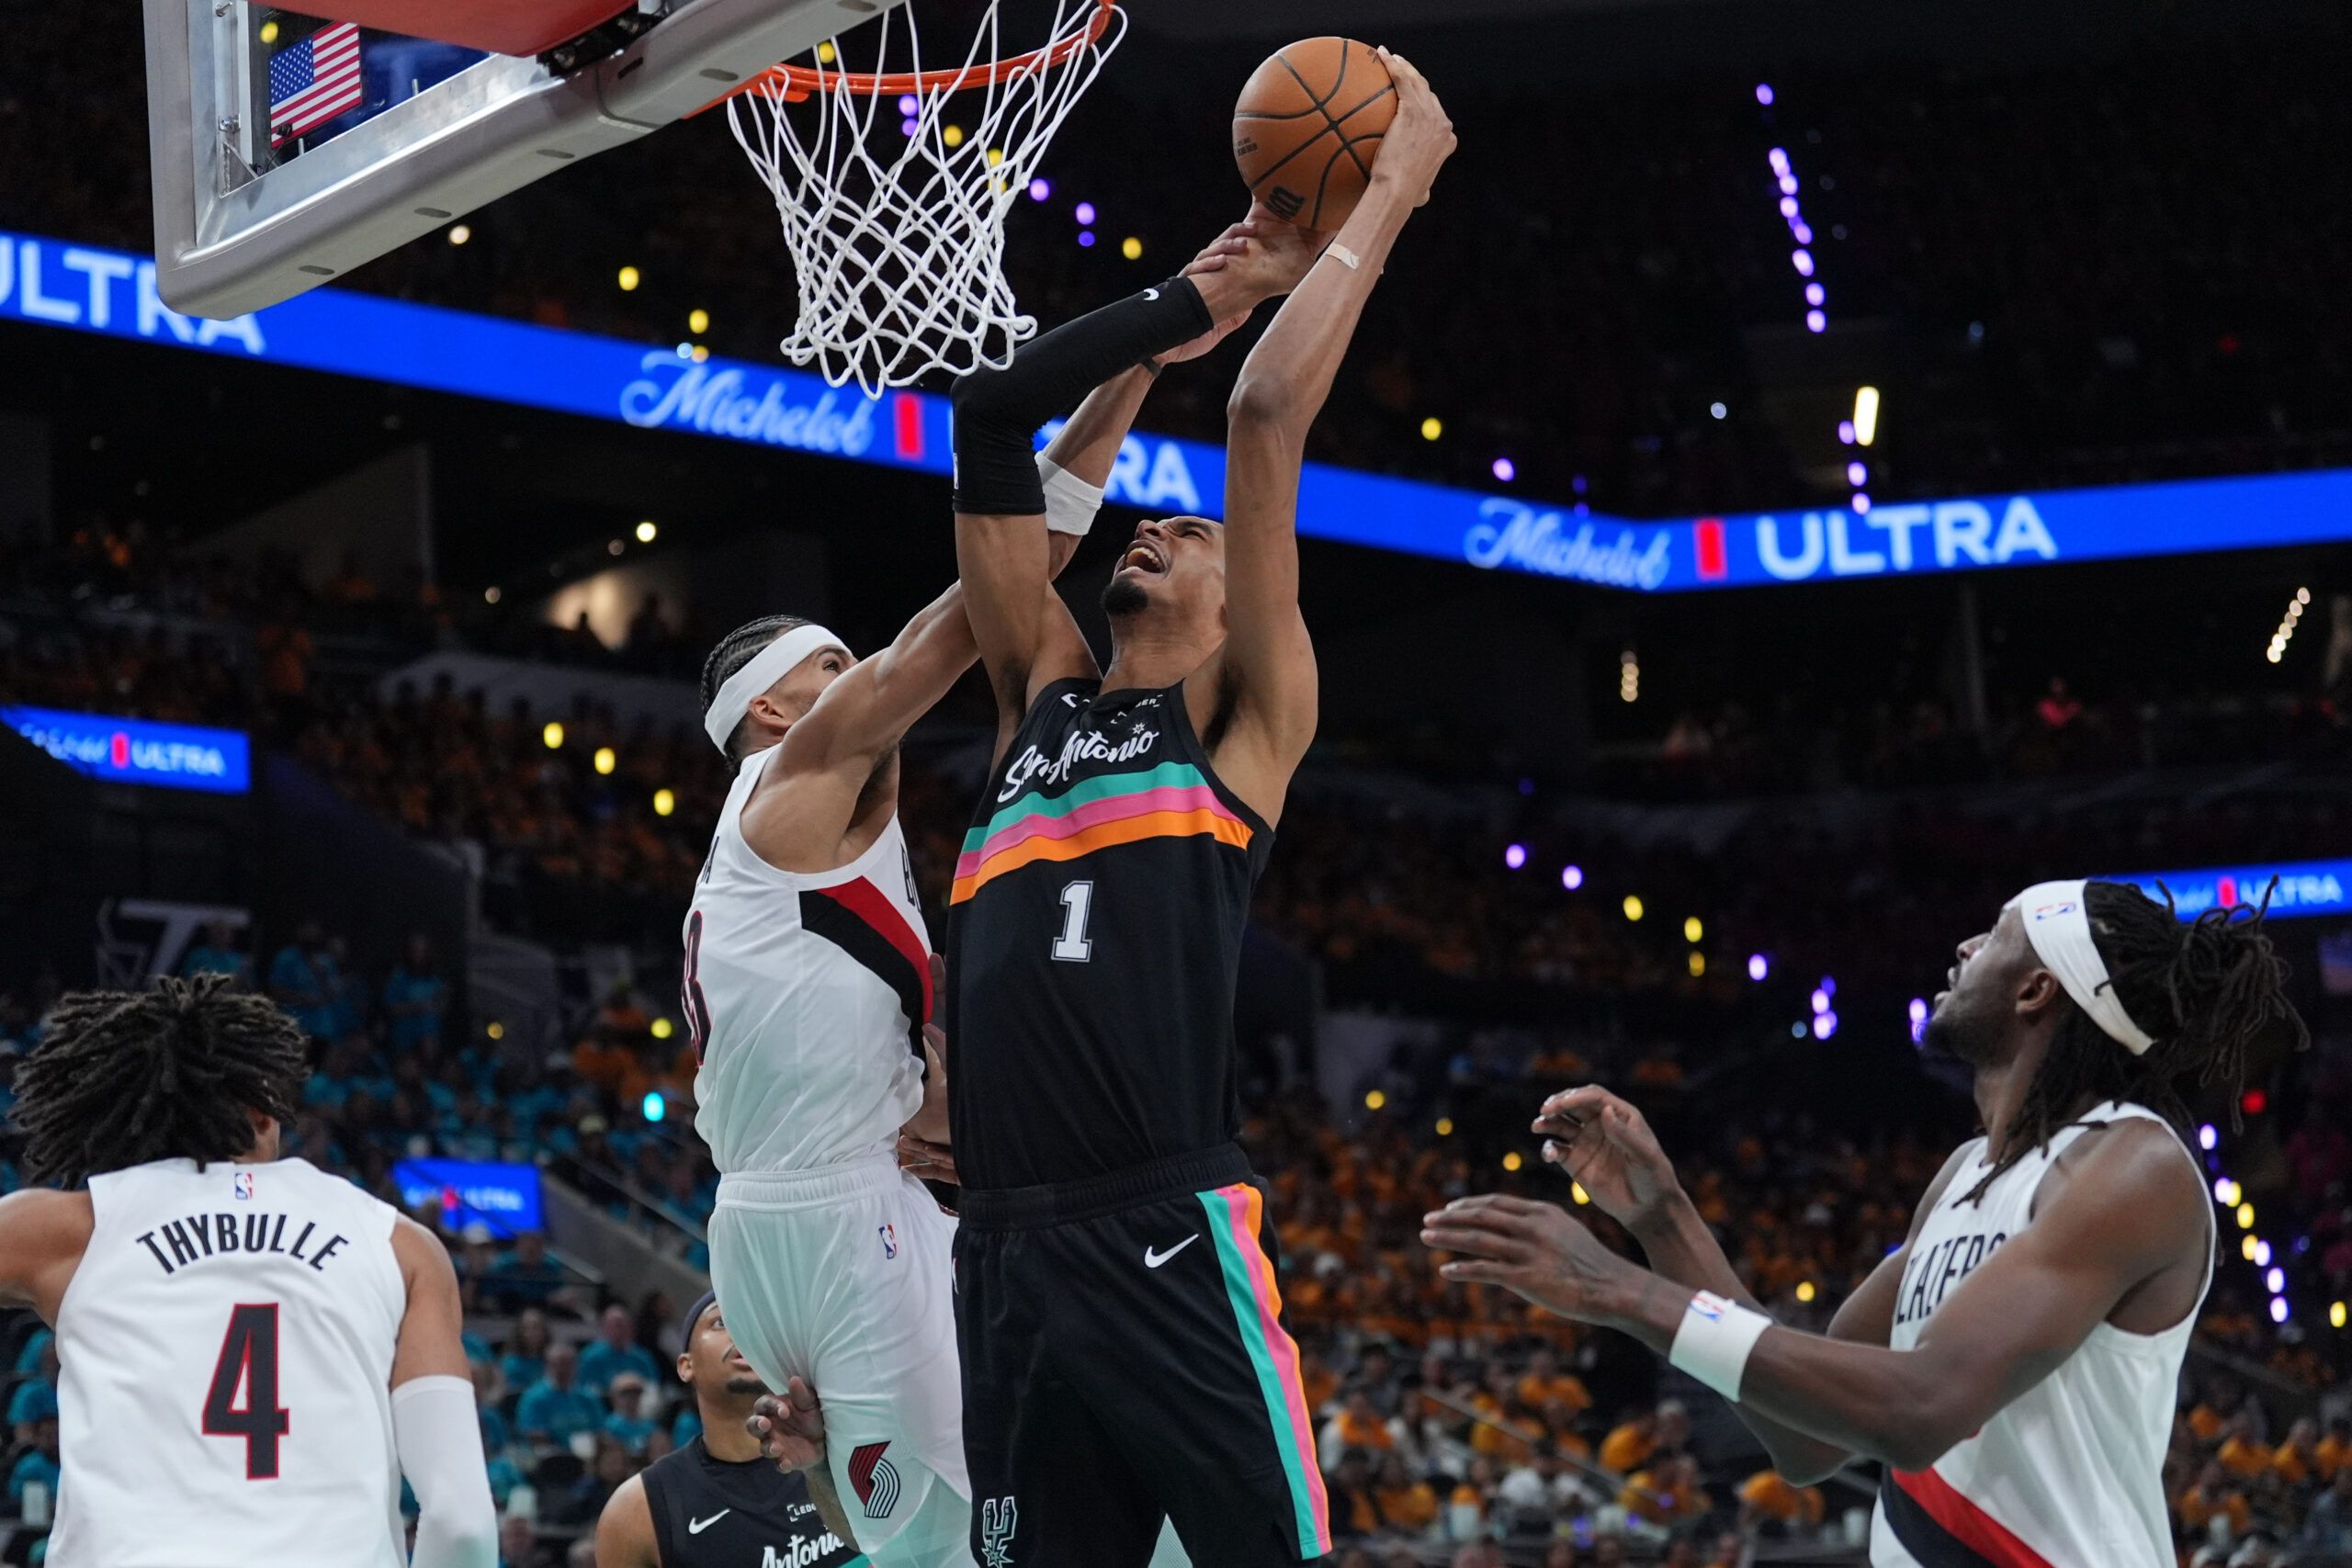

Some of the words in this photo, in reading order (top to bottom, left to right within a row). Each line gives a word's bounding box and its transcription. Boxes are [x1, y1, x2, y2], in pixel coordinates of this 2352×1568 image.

[1756, 495, 2059, 581] ULTRA
[130, 739, 227, 777] ULTRA
[998, 745, 1050, 803] San
[1046, 724, 1159, 785] Antonio
[1051, 881, 1093, 963] 1
[136, 1213, 349, 1274] THYBULLE
[201, 1303, 289, 1480] 4
